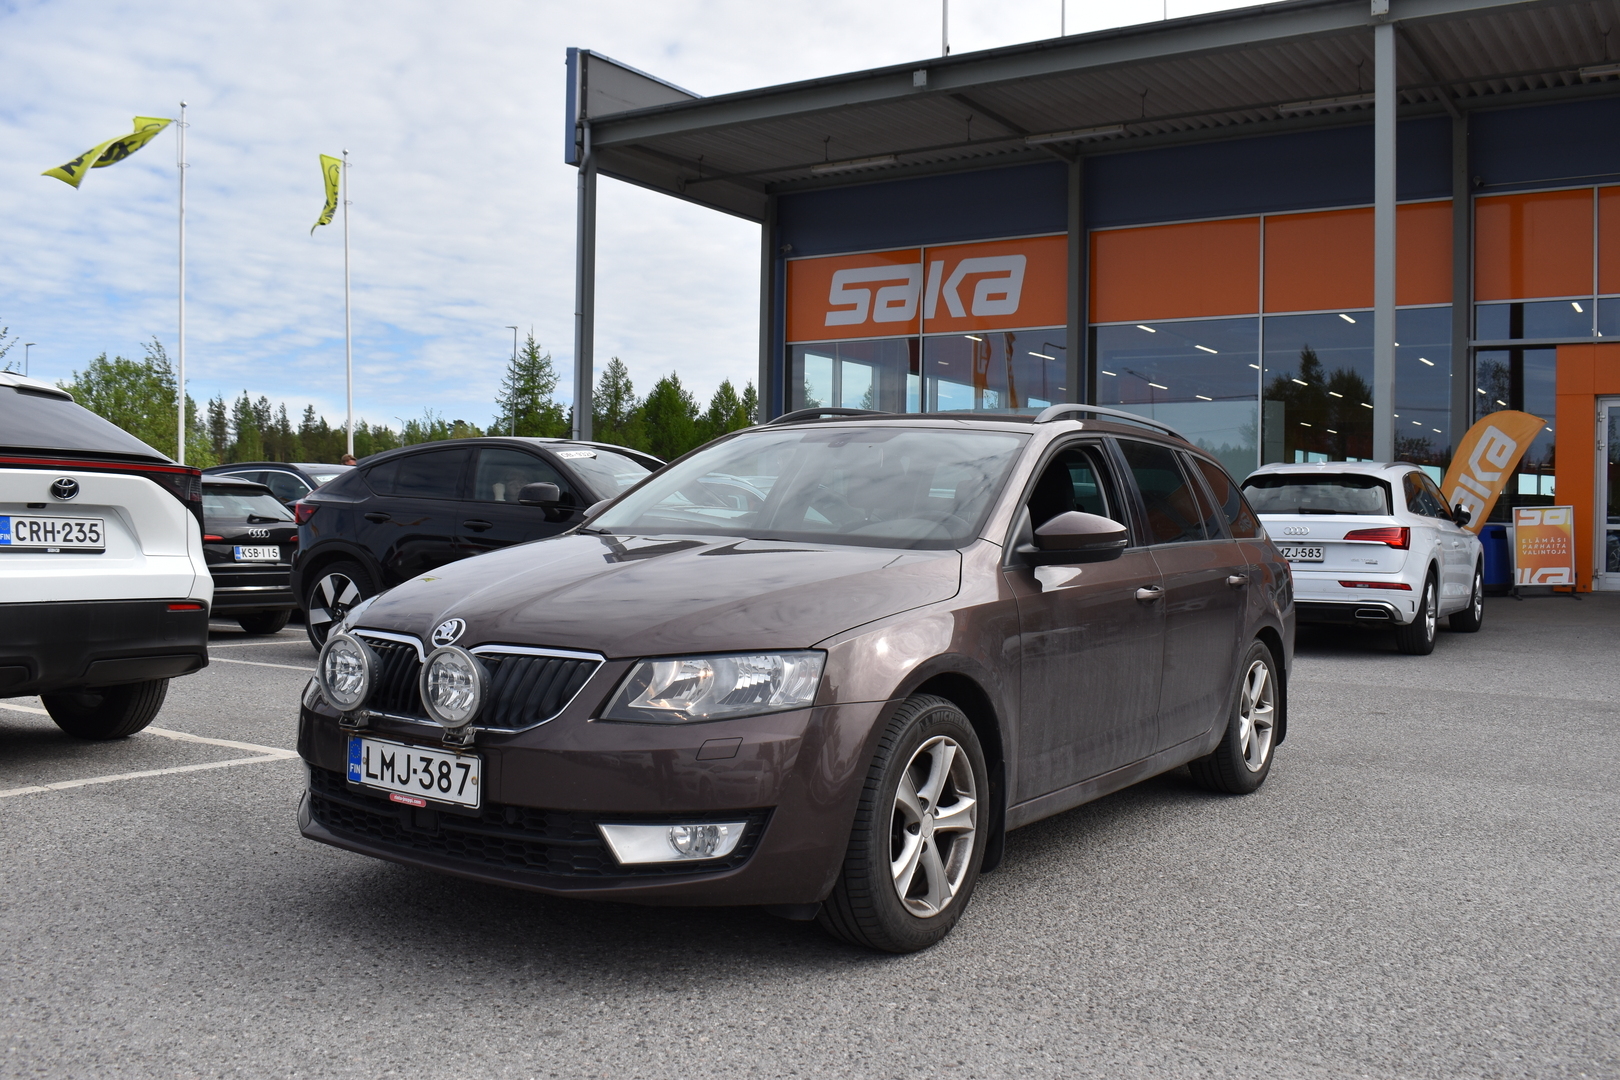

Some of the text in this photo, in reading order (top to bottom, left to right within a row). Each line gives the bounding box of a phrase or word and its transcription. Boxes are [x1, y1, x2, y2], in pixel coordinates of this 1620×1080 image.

[1449, 425, 1517, 528] aka
[15, 521, 100, 543] CRH-235
[241, 548, 278, 558] KSB-115
[350, 746, 471, 796] FIN LMJ-387
